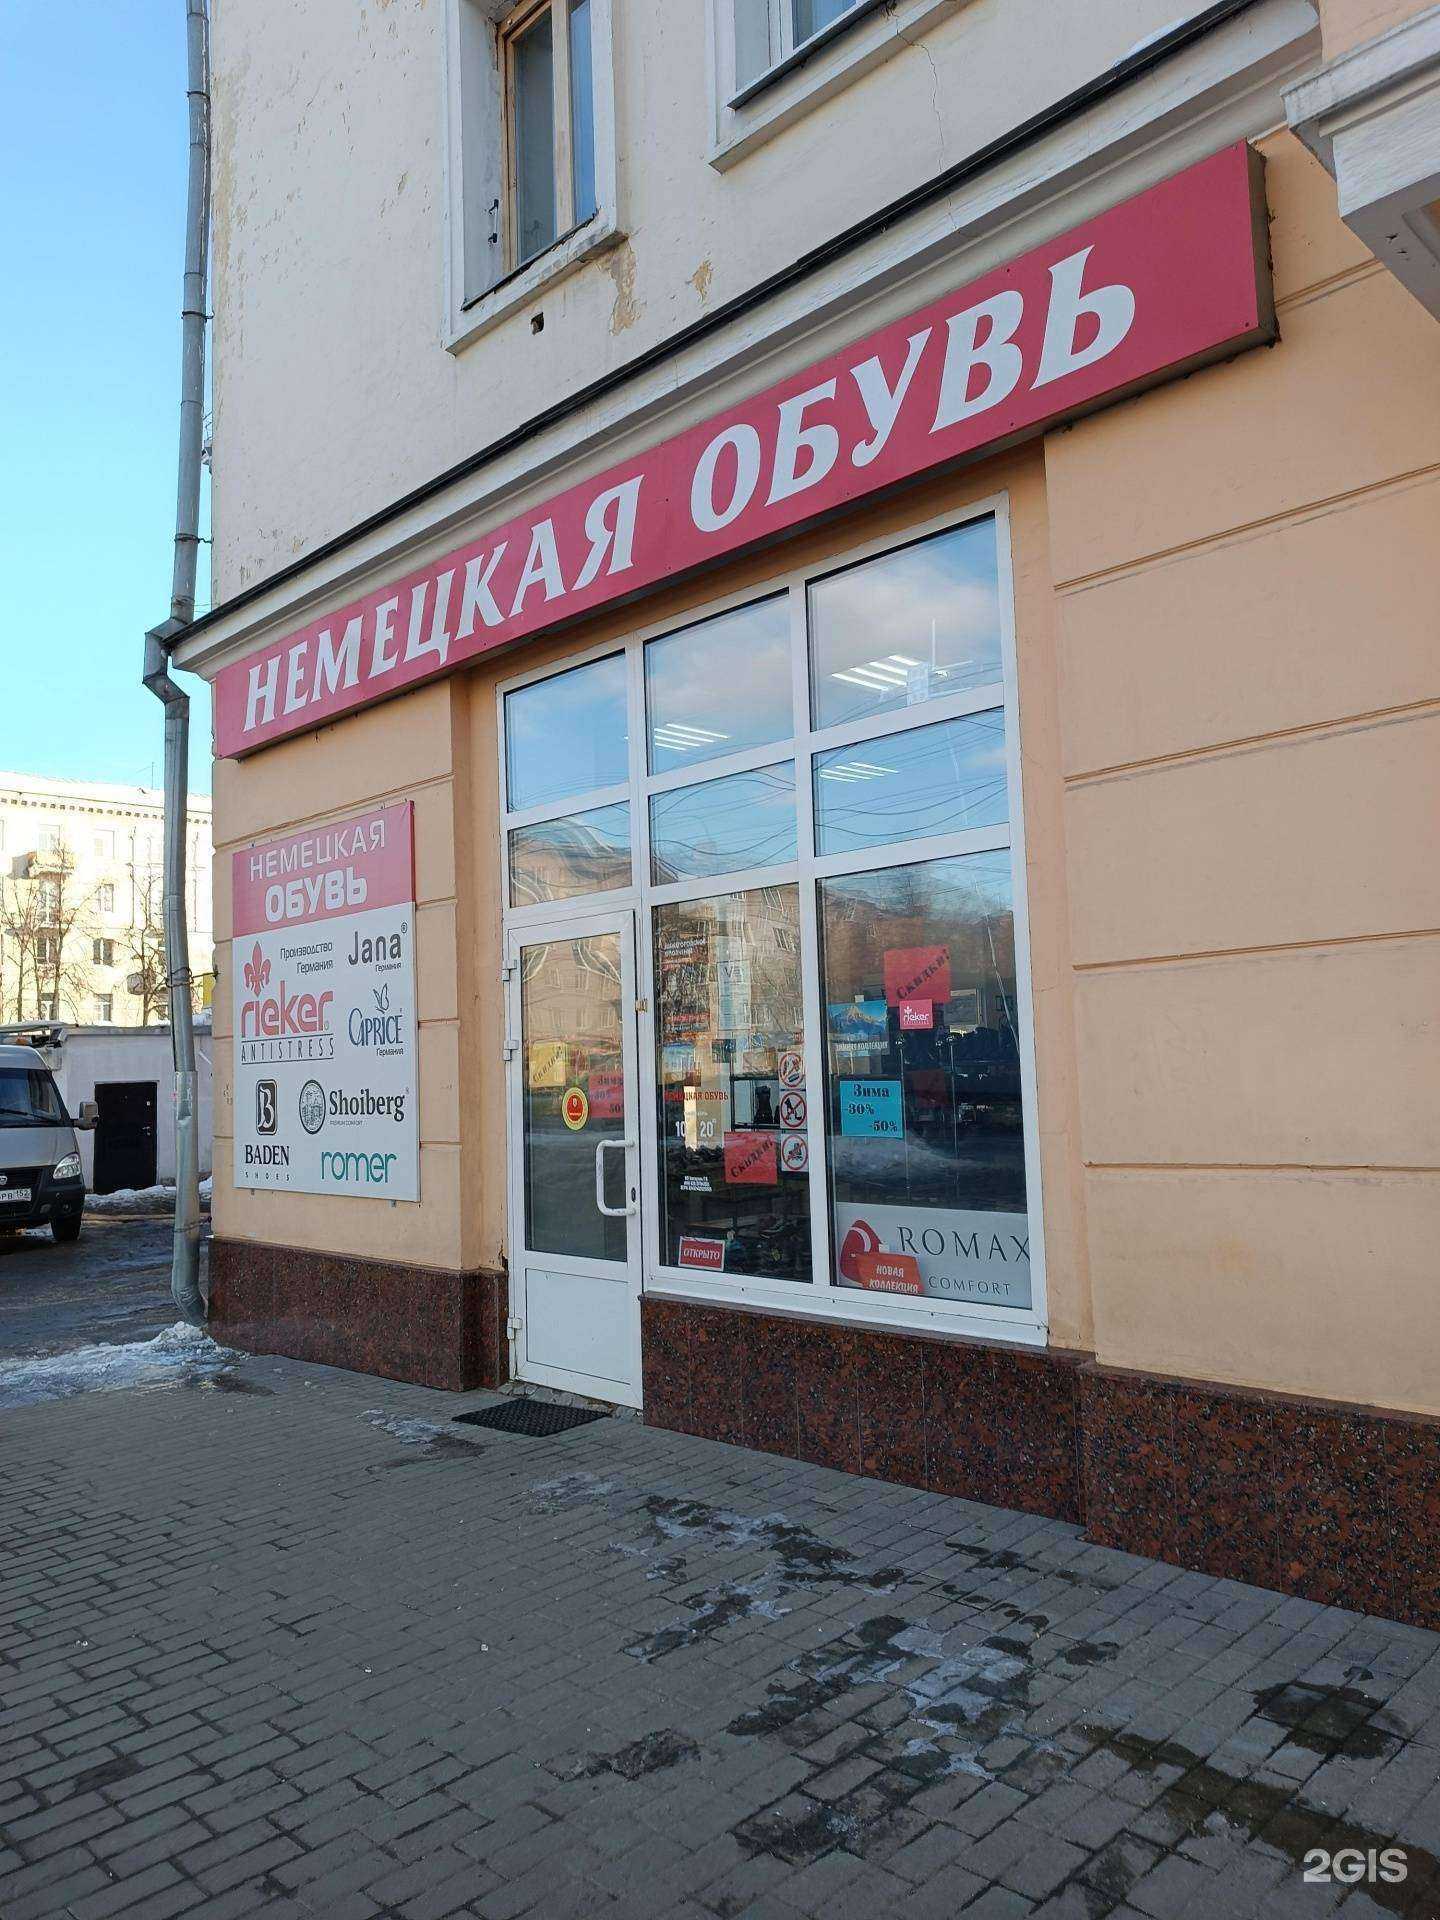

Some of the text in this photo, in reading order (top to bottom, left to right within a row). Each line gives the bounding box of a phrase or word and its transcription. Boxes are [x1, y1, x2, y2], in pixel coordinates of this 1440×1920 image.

[243, 245, 1136, 732] НЕМЕЦКАЯ ОБУВЬ
[250, 819, 385, 882] НЕМЕЦКАЯ
[265, 866, 367, 923] ОБУВЬ
[280, 942, 333, 961] Производство
[296, 960, 334, 975] Германия
[241, 981, 334, 1038] rieker
[241, 1037, 334, 1062] ANTISTRESS
[704, 1090, 729, 1101] ОБУВЬ
[853, 1083, 890, 1098] Зима
[329, 1087, 405, 1122] Shoiberg
[245, 1144, 290, 1166] BADEN
[245, 1171, 291, 1182] SHOES
[321, 1150, 397, 1183] romer
[683, 1247, 720, 1261] ОТКРЫТО
[897, 1226, 1030, 1262] ROMAX
[876, 1264, 905, 1277] НОВАЯ
[868, 1279, 919, 1294] КОЛЛЕКЦИЯ
[928, 1275, 1011, 1296] COMFORT
